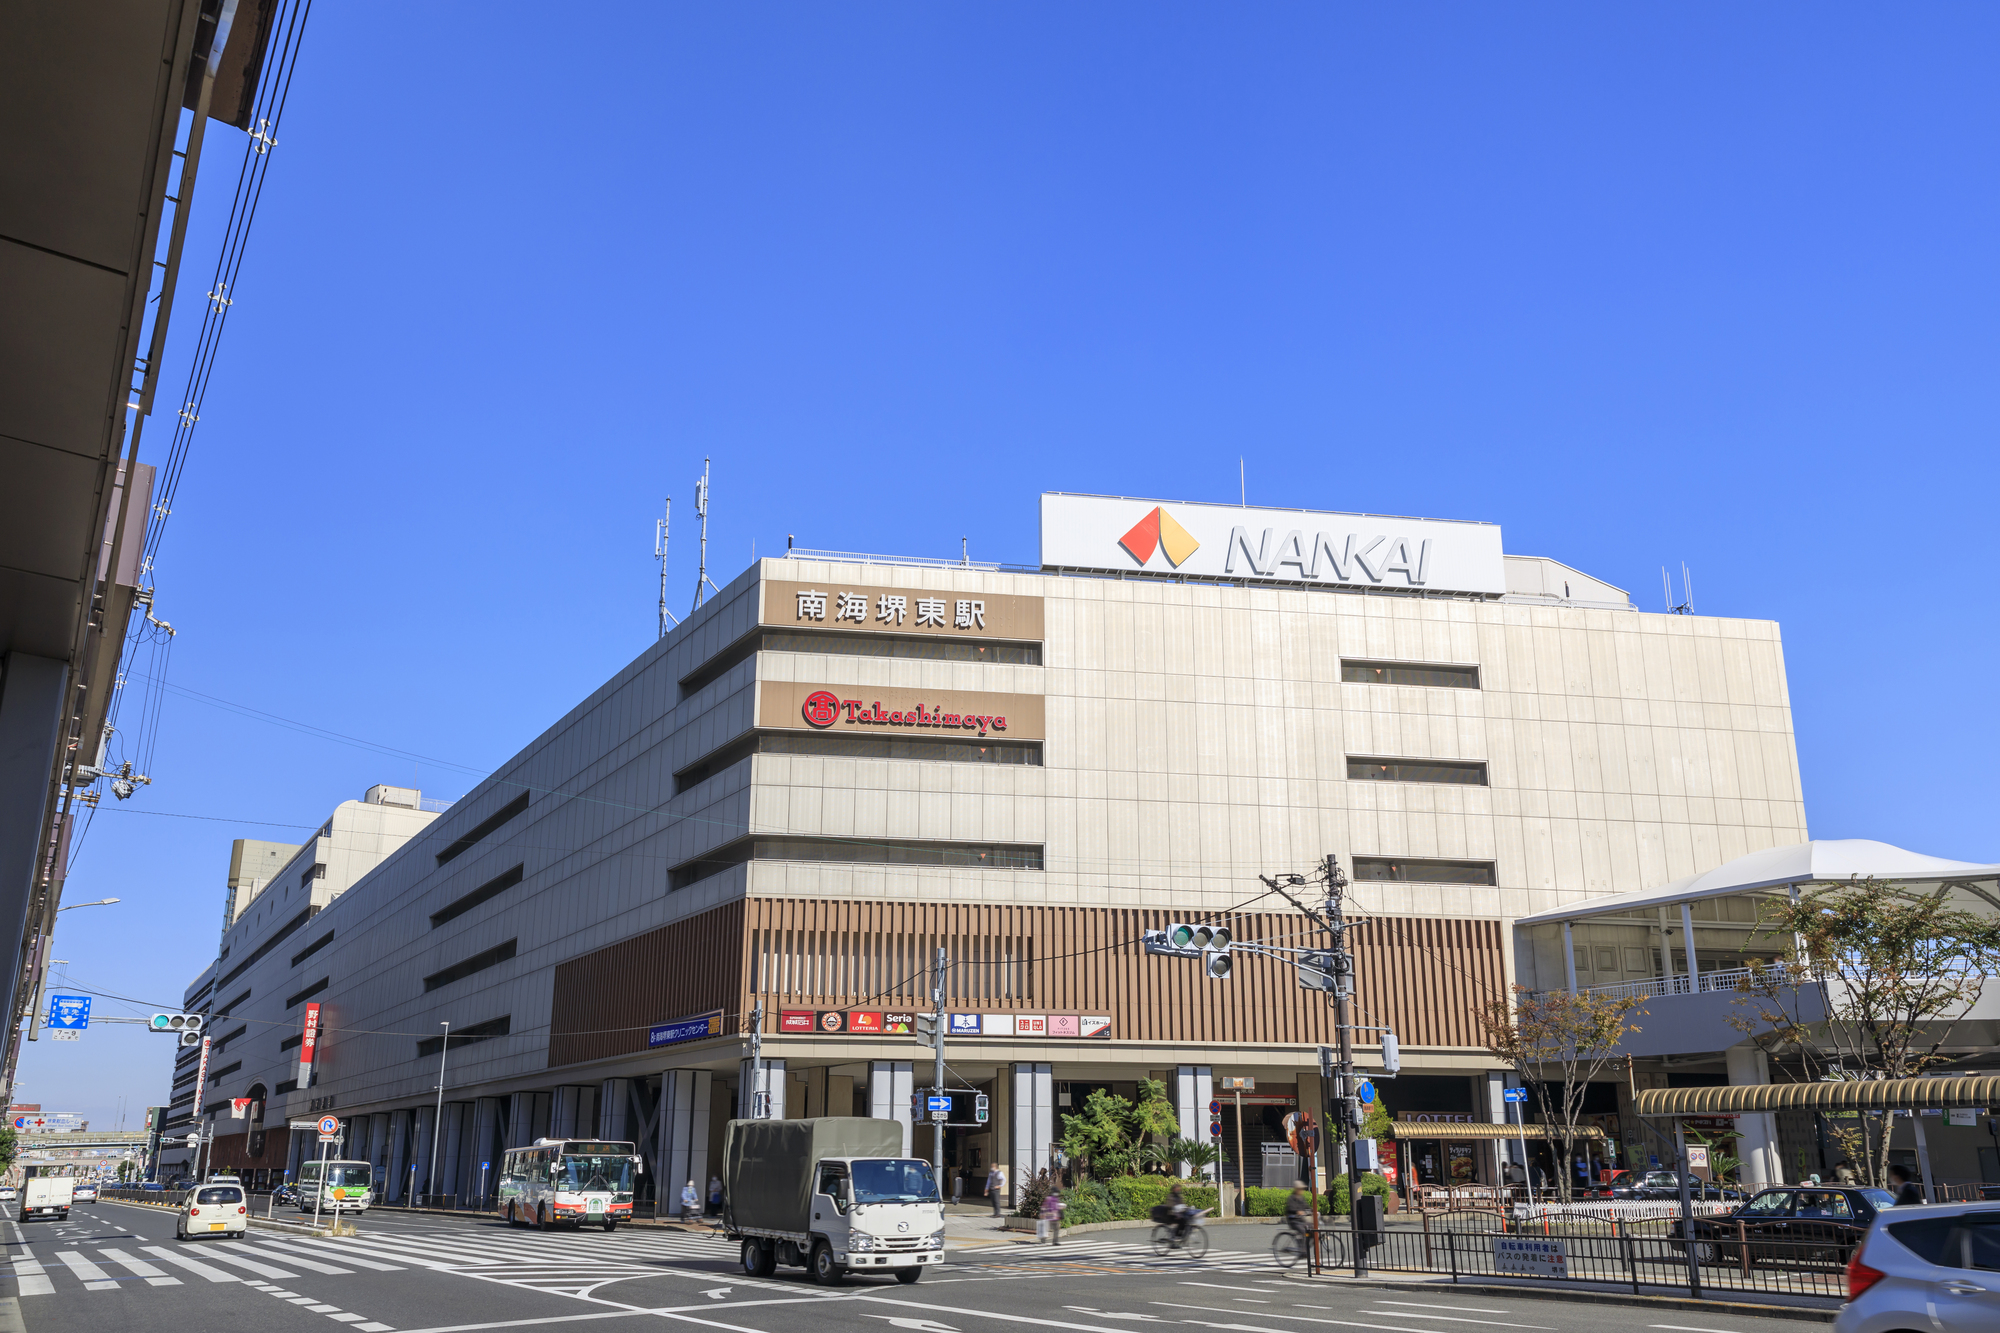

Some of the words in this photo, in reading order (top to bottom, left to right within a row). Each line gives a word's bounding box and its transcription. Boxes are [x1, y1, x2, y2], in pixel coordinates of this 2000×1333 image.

[1225, 525, 1432, 585] NANKAI
[797, 589, 986, 628] 南海堺東駅
[843, 699, 1008, 733] Takashimaya
[61, 1008, 79, 1016] 優先
[886, 1013, 912, 1023] Seria
[304, 1010, 319, 1047] 野村證券
[196, 1048, 210, 1113] TAKASHIMAYA
[1498, 1252, 1564, 1264] バスの発着に注意
[1501, 1241, 1558, 1253] 自転車利用者は
[1551, 1266, 1565, 1274] 堺市
